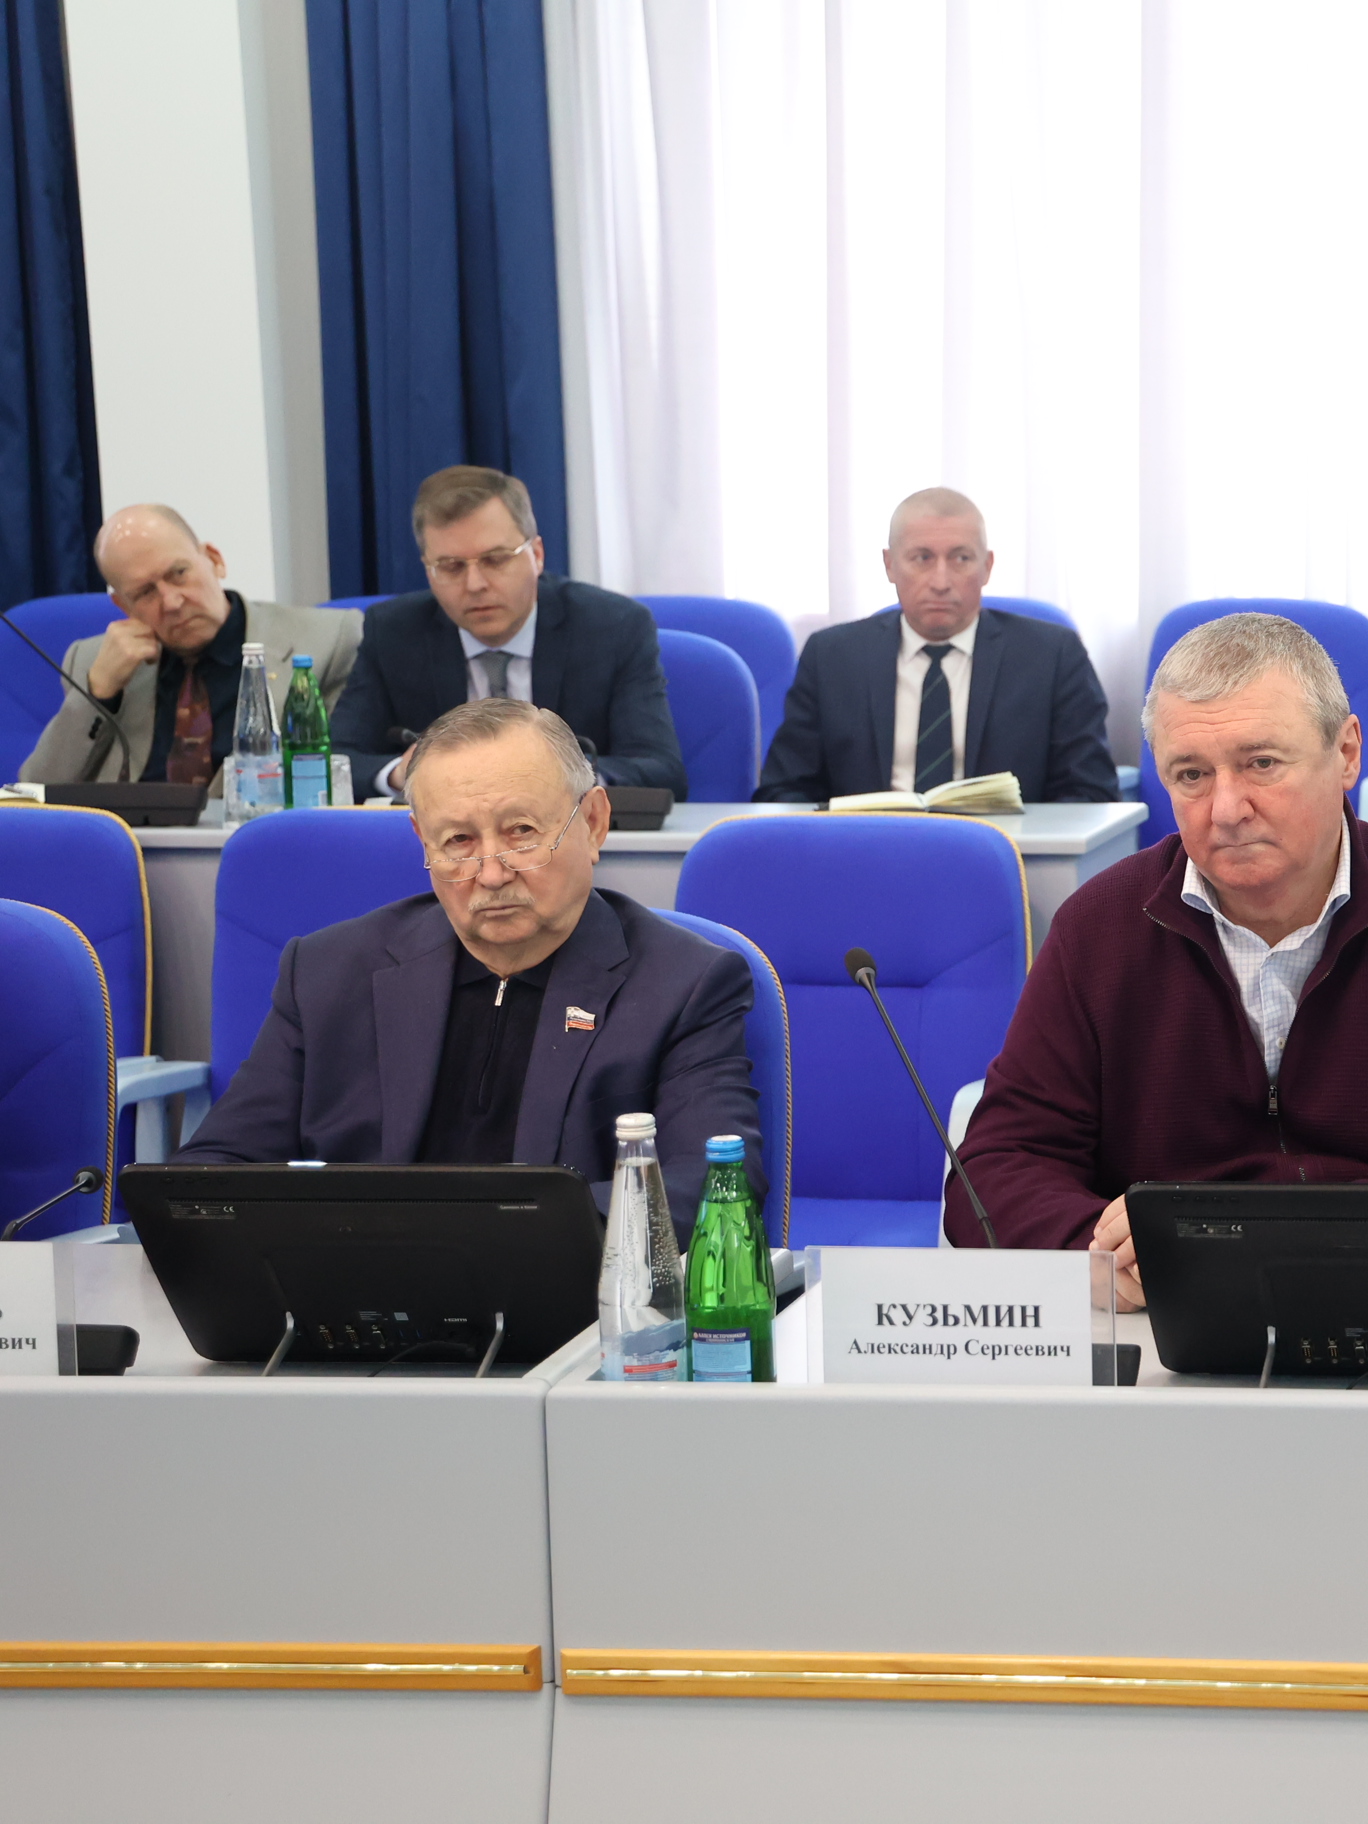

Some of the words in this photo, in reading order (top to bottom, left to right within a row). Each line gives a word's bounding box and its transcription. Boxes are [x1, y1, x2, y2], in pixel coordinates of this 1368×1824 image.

[875, 1302, 1042, 1329] КУЗЬМИН
[0, 1337, 37, 1350] вич
[847, 1338, 957, 1360] Александр
[963, 1339, 1071, 1360] Сергеевич
